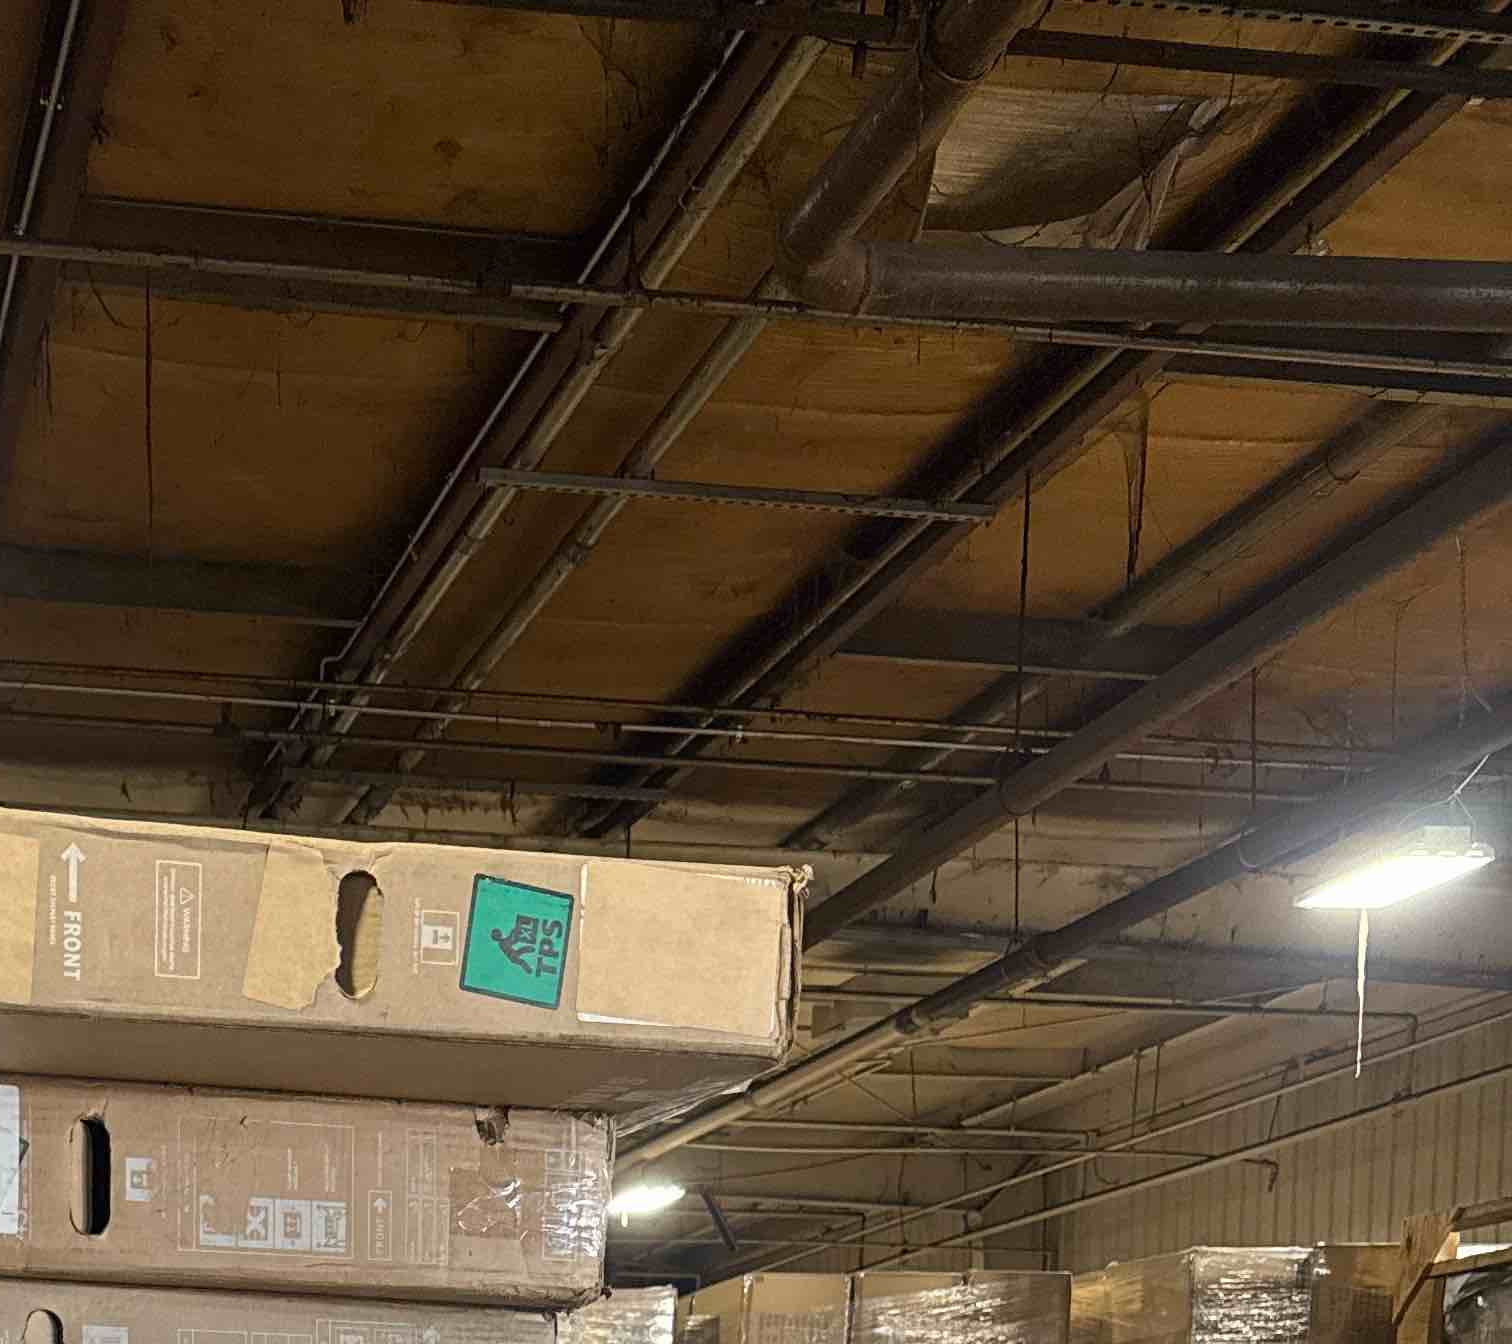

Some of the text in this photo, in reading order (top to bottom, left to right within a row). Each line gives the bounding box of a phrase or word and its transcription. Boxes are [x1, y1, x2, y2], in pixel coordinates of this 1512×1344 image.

[63, 910, 82, 982] FRONT
[536, 918, 564, 978] TPS
[375, 1216, 385, 1257] FRONT
